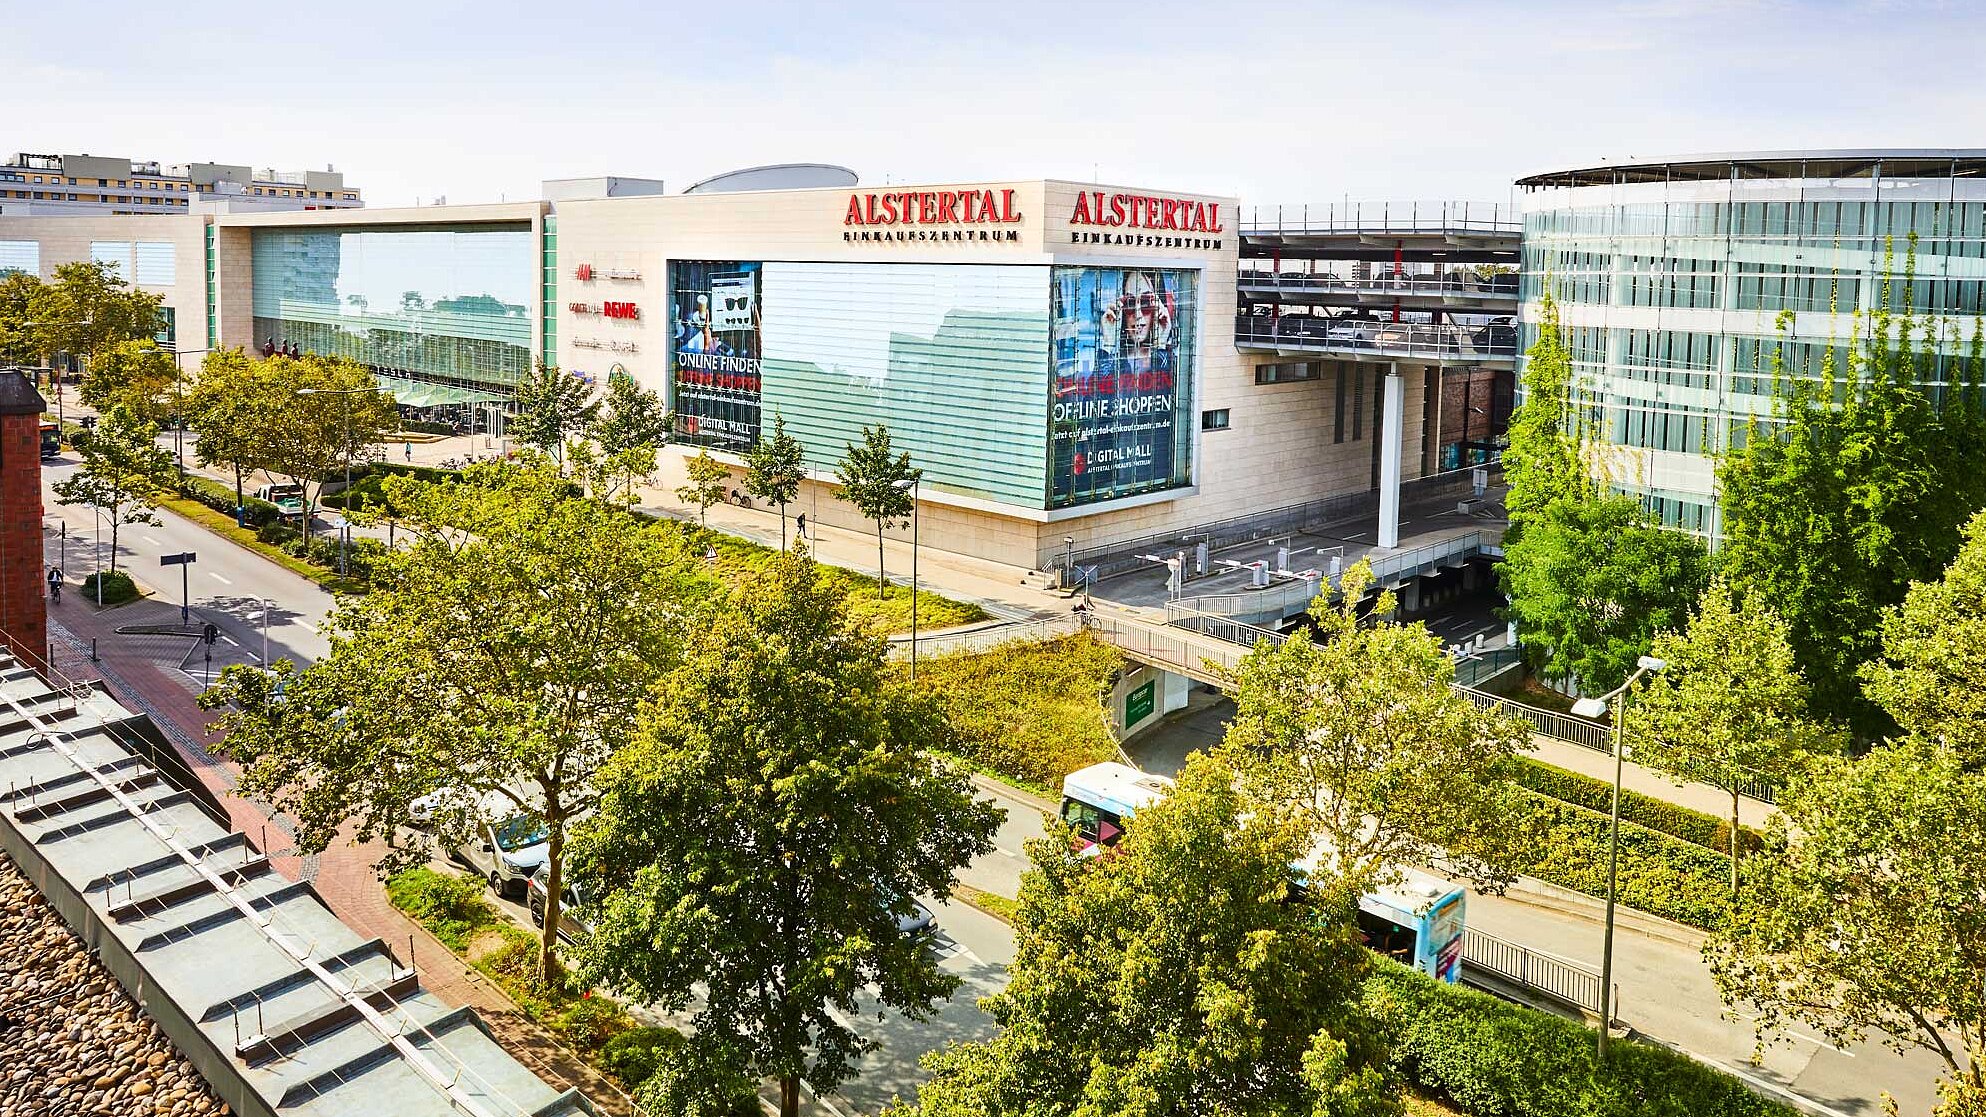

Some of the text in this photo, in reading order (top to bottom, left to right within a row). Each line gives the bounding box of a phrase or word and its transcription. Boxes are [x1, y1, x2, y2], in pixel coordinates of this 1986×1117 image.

[844, 189, 1021, 225] ALSTERTAL
[1070, 190, 1223, 233] ALSTERTAL
[843, 230, 1018, 242] EINKAUFSZENTRUM
[1071, 232, 1222, 249] EINKAUFSZENTRUM
[603, 301, 638, 319] REWE
[679, 353, 762, 374] ONLINE FINDEN
[716, 373, 761, 392] SHOPPEN
[1053, 394, 1171, 422] OFFLINE SHOPPEN
[698, 417, 751, 434] DIGITAL MALL
[1052, 430, 1068, 440] etzt
[1087, 444, 1152, 465] DIGITAL MALL
